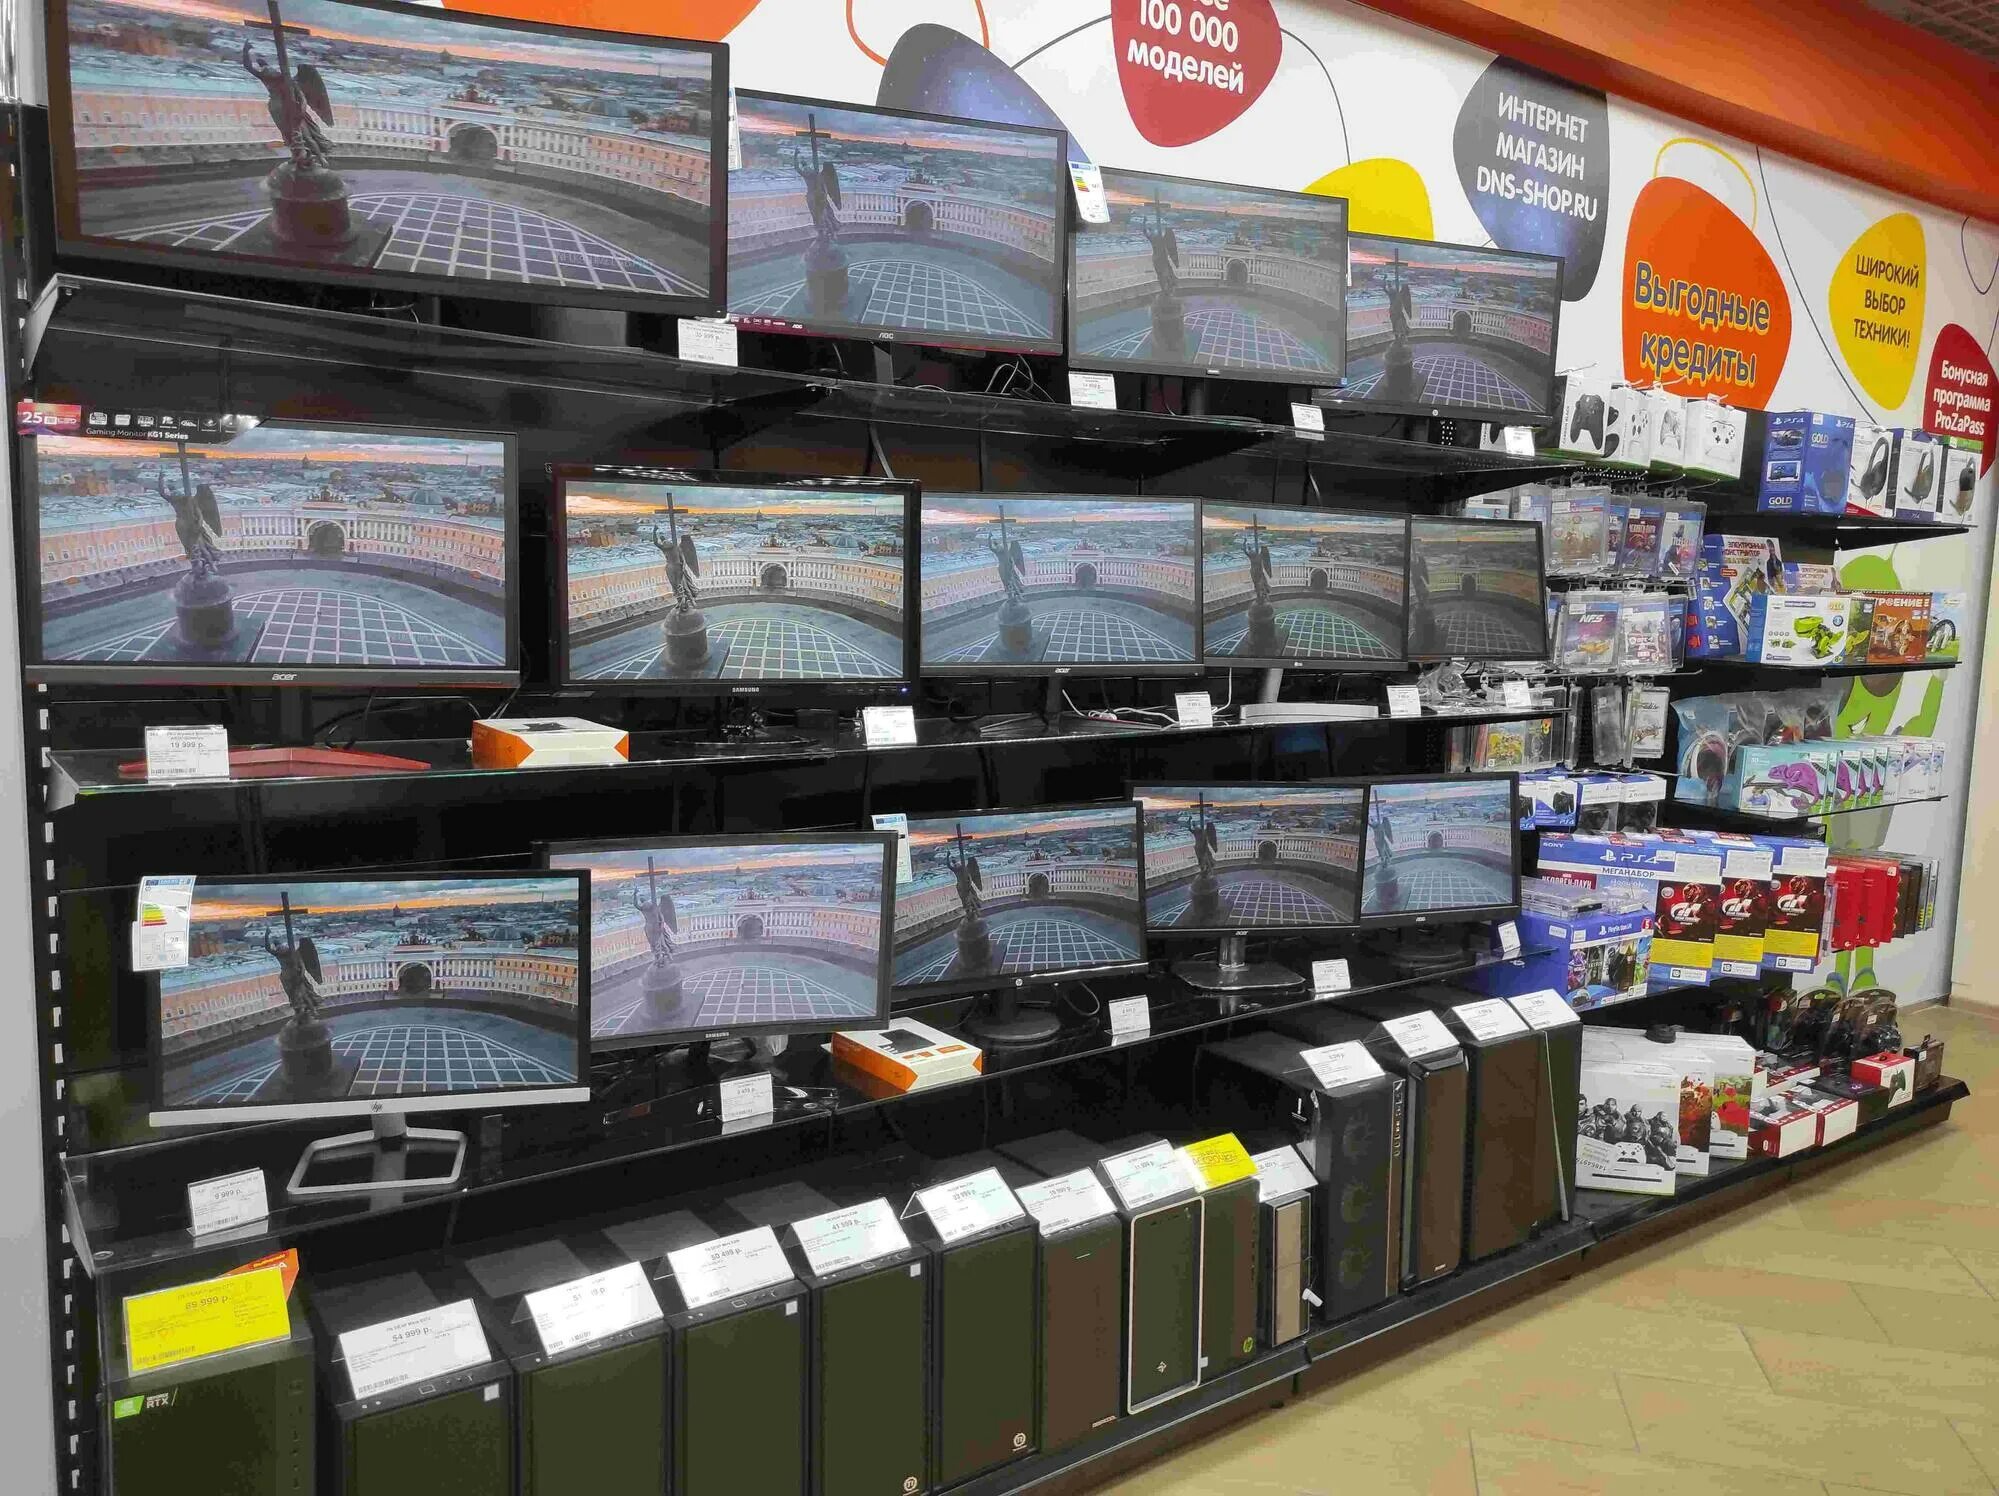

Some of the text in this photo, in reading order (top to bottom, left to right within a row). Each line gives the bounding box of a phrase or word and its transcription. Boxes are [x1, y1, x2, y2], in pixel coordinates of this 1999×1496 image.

[1139, 0, 1239, 53] 100 000
[1127, 38, 1244, 94] моделей
[1498, 91, 1589, 143] ИНТЕРНЕТ
[1495, 131, 1585, 181] МАГАЗИН
[1476, 165, 1598, 221] DNS-SHOP.RU
[1856, 254, 1920, 288] ШИРОКИЙ
[1634, 261, 1770, 336] Выгодные
[1864, 289, 1906, 315] ВЫБОР
[1854, 318, 1911, 349] ТЕХНИКИ!
[1640, 331, 1757, 388] кредиты
[1941, 359, 1988, 387] Бонусная
[1933, 387, 1991, 412] программа
[22, 412, 43, 424] 25
[1934, 409, 1985, 436] ProZaPass
[86, 427, 189, 440] Gaming Monitor KG1 Series
[1811, 432, 1829, 444] GOLD
[1768, 496, 1793, 506] GOLD
[1579, 614, 1605, 623] NFS
[272, 673, 297, 681] acer
[182, 741, 196, 749] 999
[1543, 841, 1565, 849] SONY
[1620, 851, 1658, 865] PS4
[1601, 866, 1656, 878] МЕГАНАБОР
[705, 1031, 730, 1039] SAMSUNG
[392, 1333, 403, 1342] 54
[405, 1330, 421, 1340] 999
[147, 1397, 169, 1409] RTX
